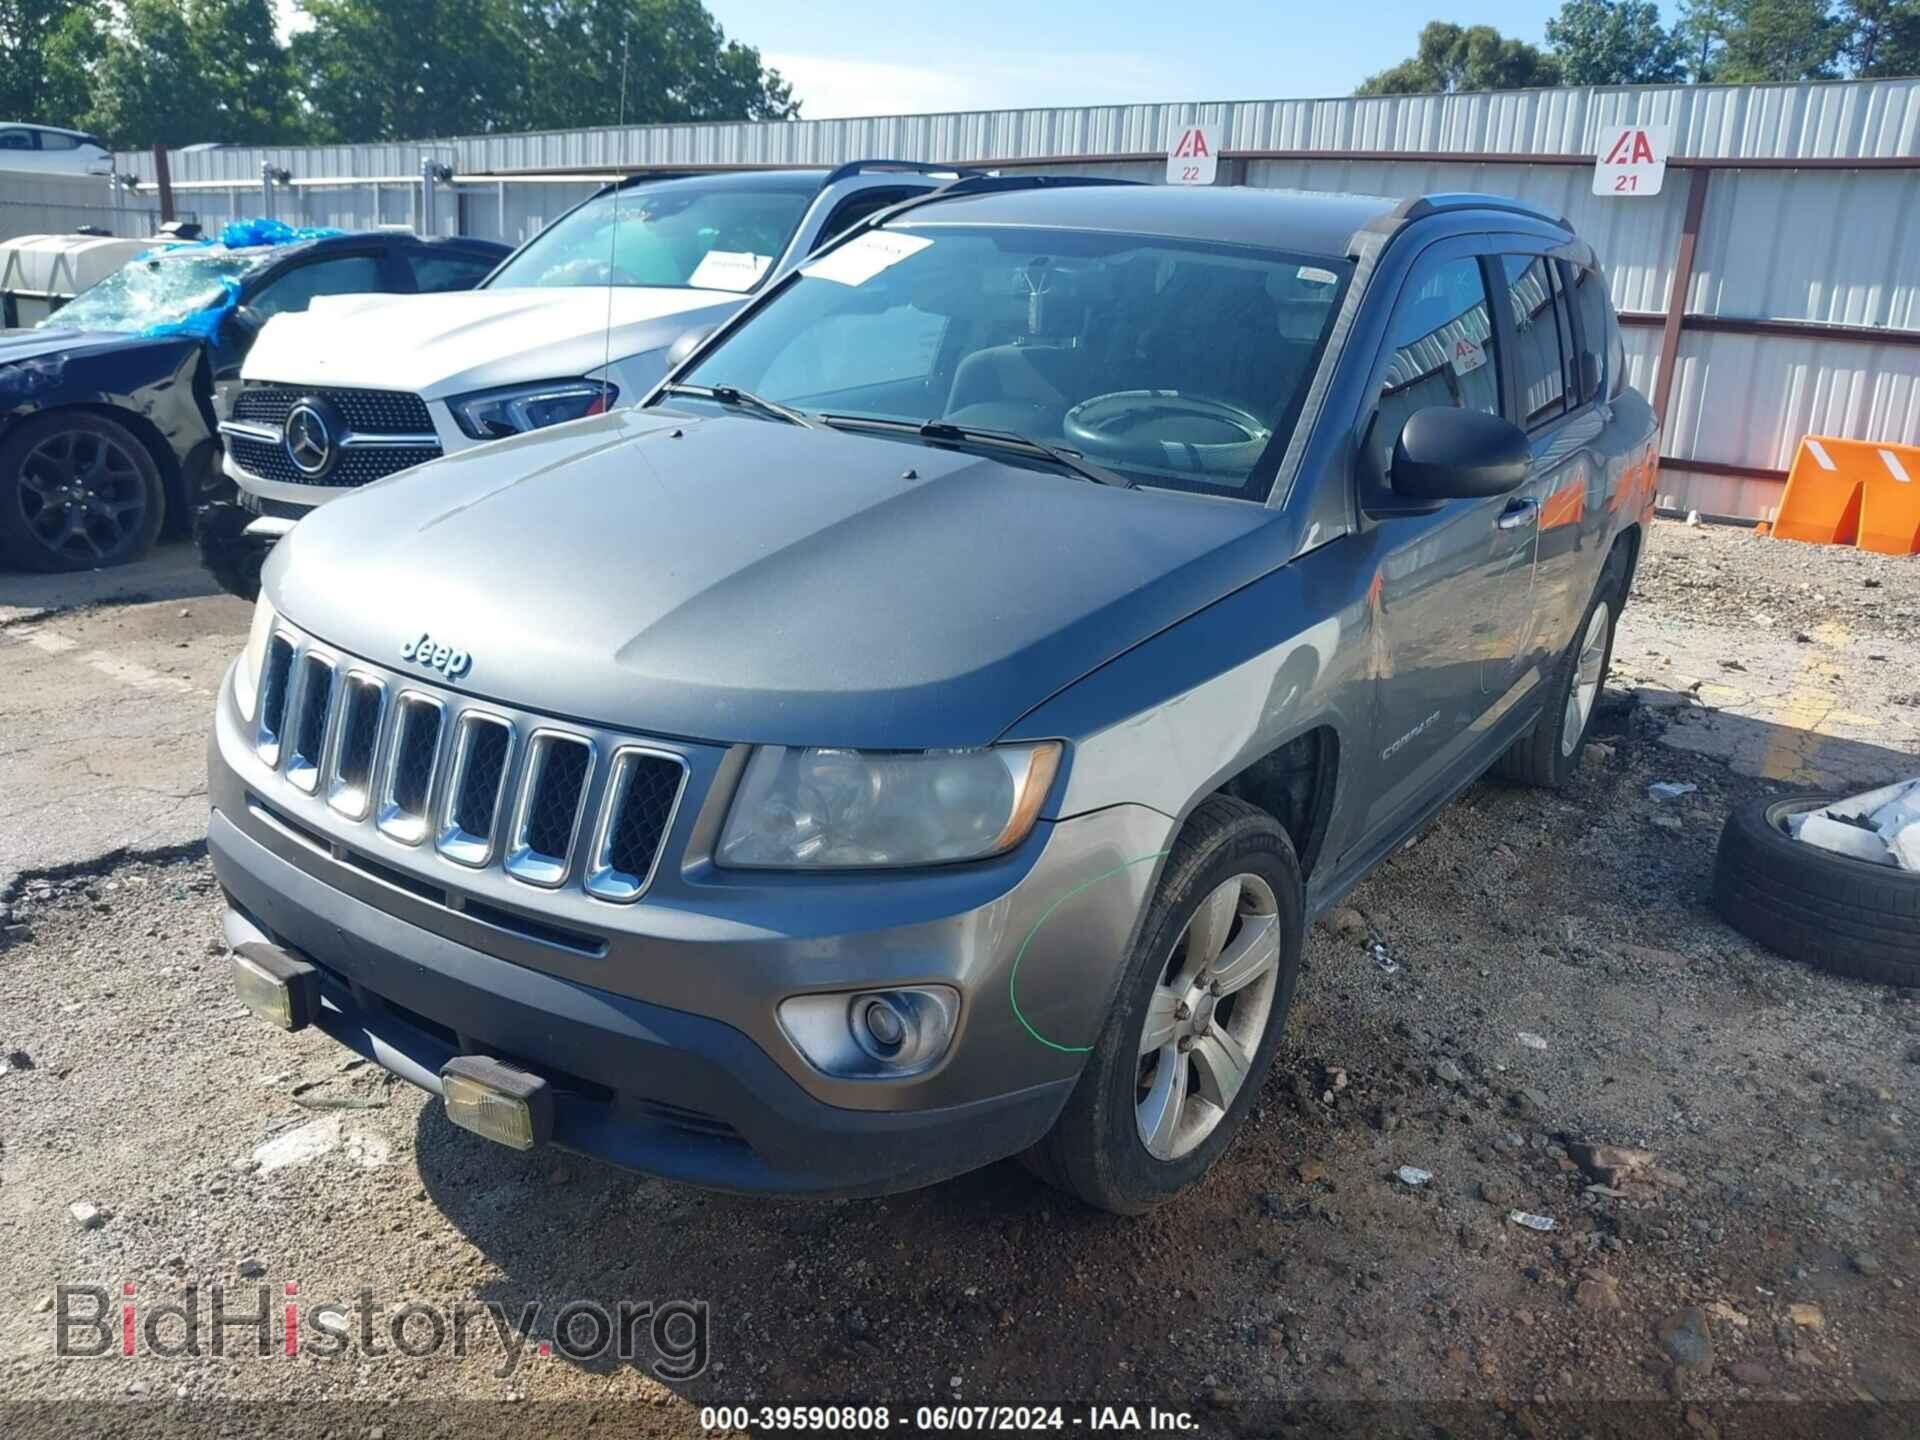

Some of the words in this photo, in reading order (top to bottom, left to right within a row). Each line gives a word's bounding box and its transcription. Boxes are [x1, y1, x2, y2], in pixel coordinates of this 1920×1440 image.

[1182, 166, 1200, 180] 22
[1614, 175, 1638, 191] 21
[400, 632, 472, 682] Jeep
